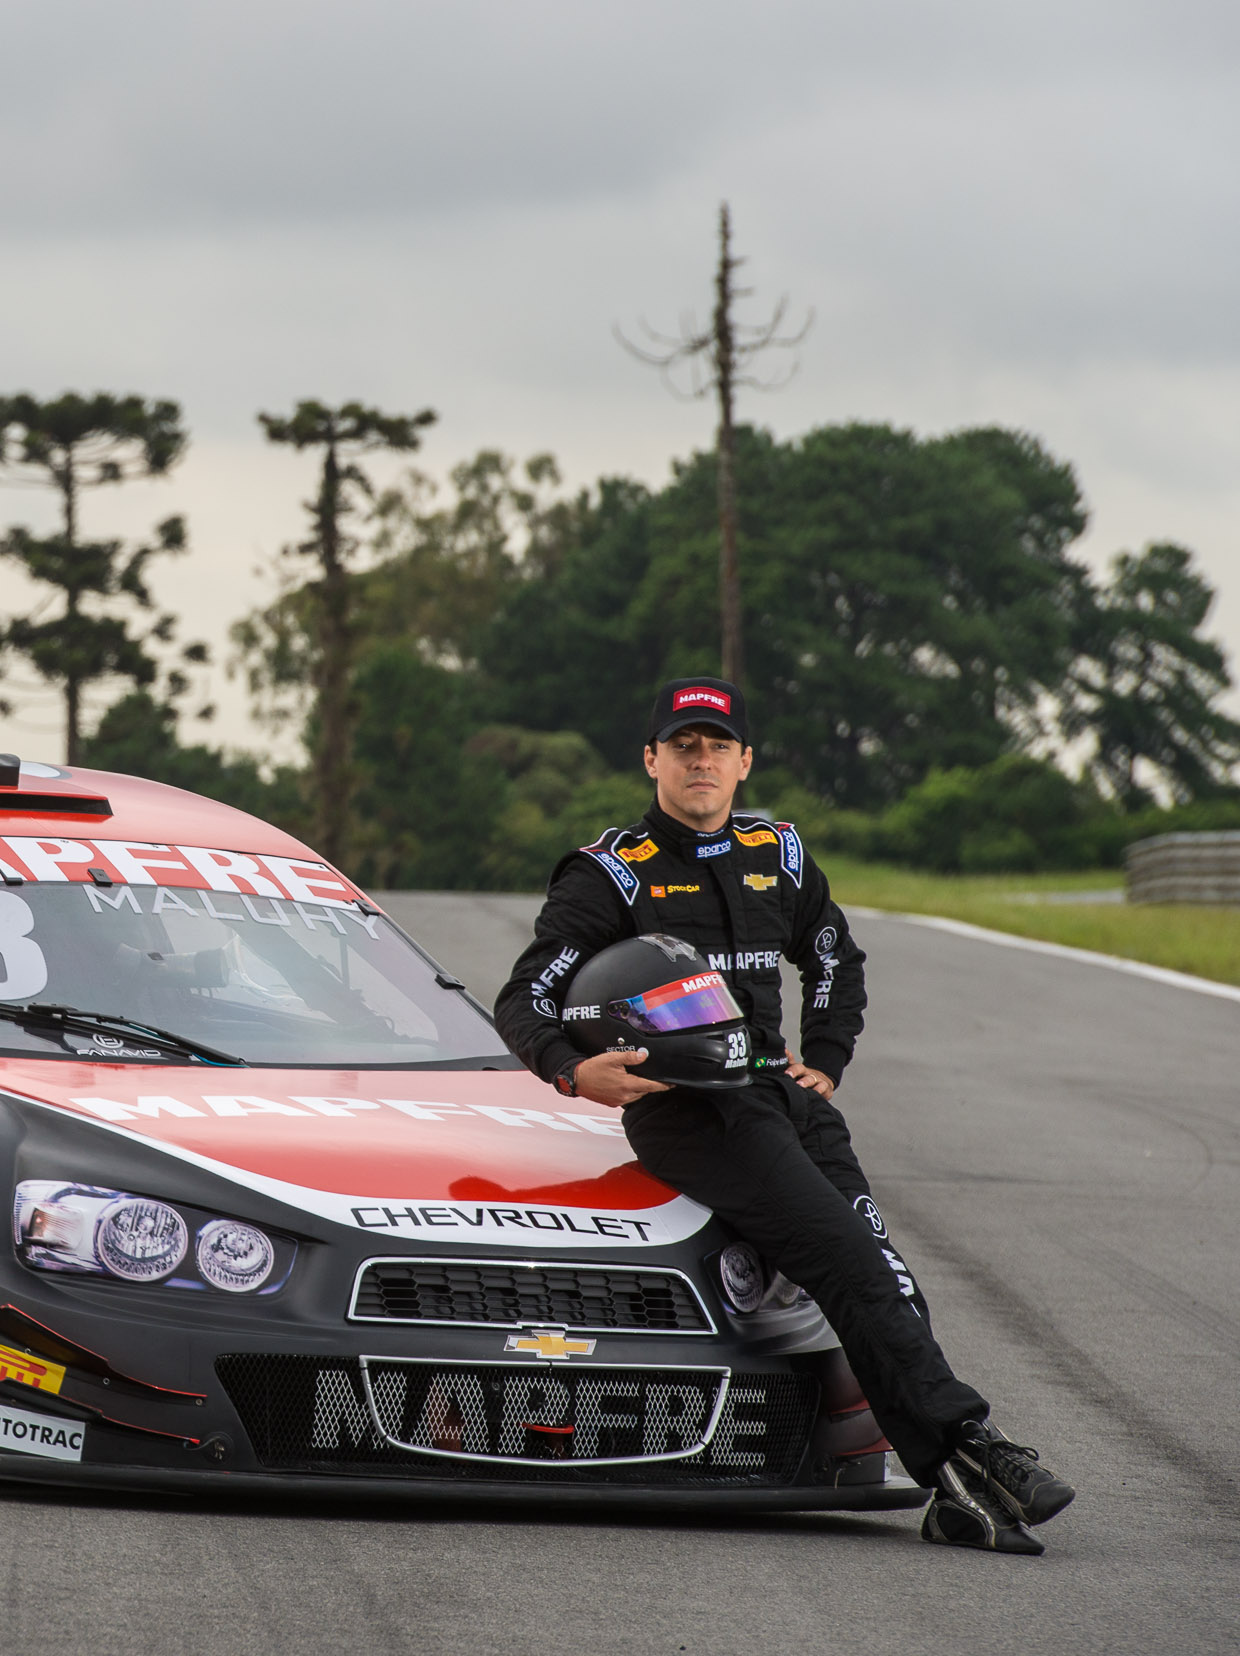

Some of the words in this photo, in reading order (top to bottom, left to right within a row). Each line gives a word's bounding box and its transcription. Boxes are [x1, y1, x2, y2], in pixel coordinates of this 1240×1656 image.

[679, 693, 726, 707] MAPFRE
[82, 884, 380, 940] MALUHY
[562, 1005, 601, 1021] APFRE
[76, 1049, 161, 1057] FANAVID
[728, 1032, 747, 1060] 33
[68, 1095, 626, 1138] MAPFRE
[351, 1207, 652, 1242] CHEVROLET
[312, 1369, 767, 1465] MAPFRE
